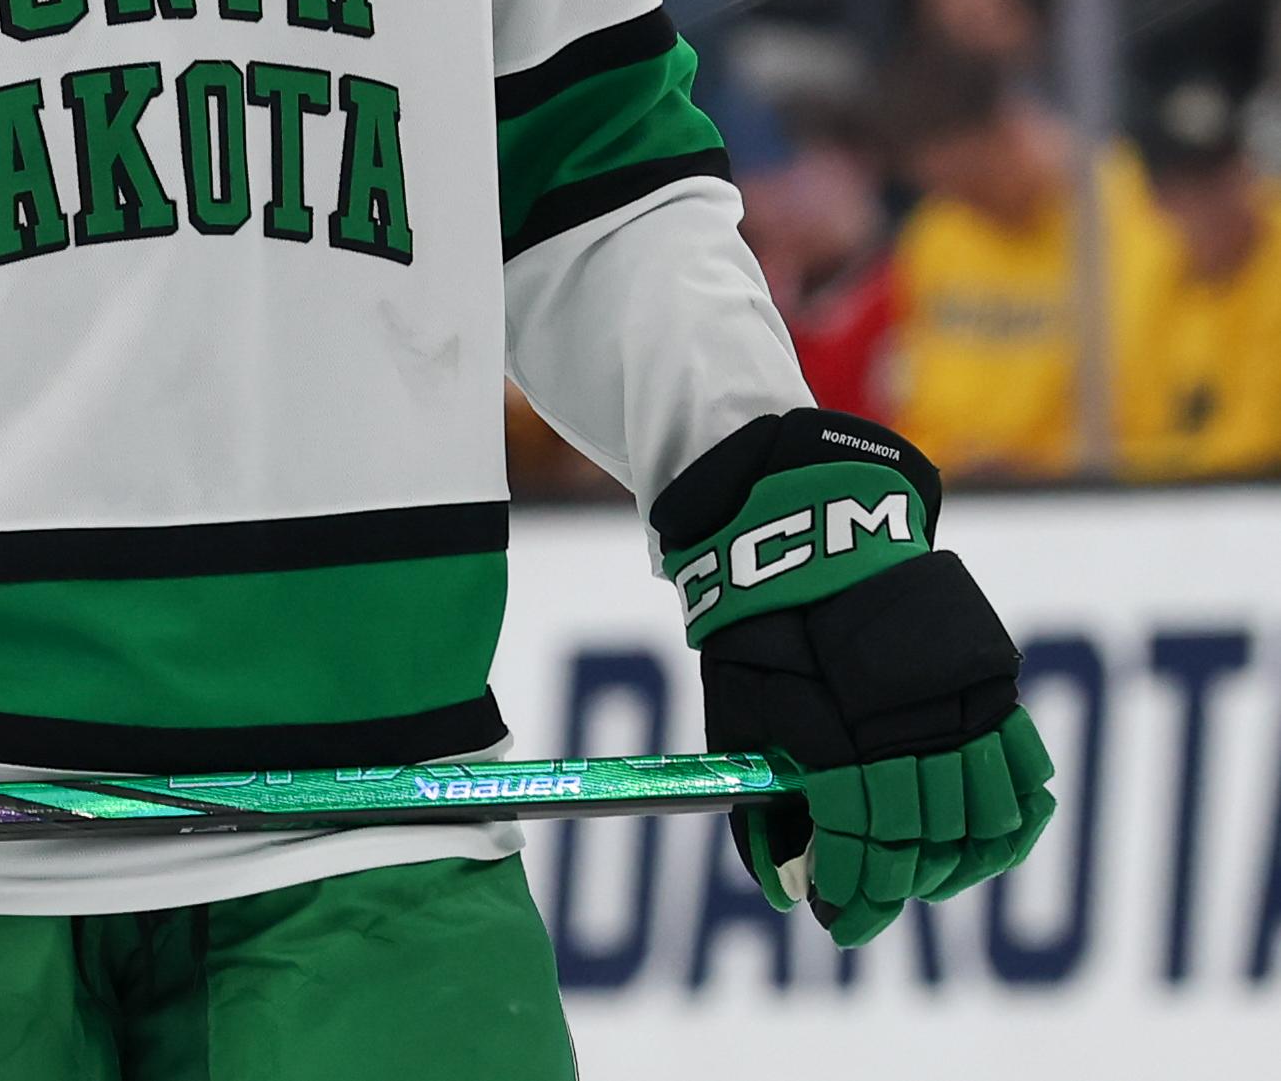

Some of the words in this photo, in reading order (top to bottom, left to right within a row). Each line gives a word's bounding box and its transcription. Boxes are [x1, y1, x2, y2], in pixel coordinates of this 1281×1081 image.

[821, 429, 861, 449] NORTH
[861, 439, 901, 462] DAKOTA
[674, 490, 914, 628] CCM
[443, 775, 582, 800] BAUER
